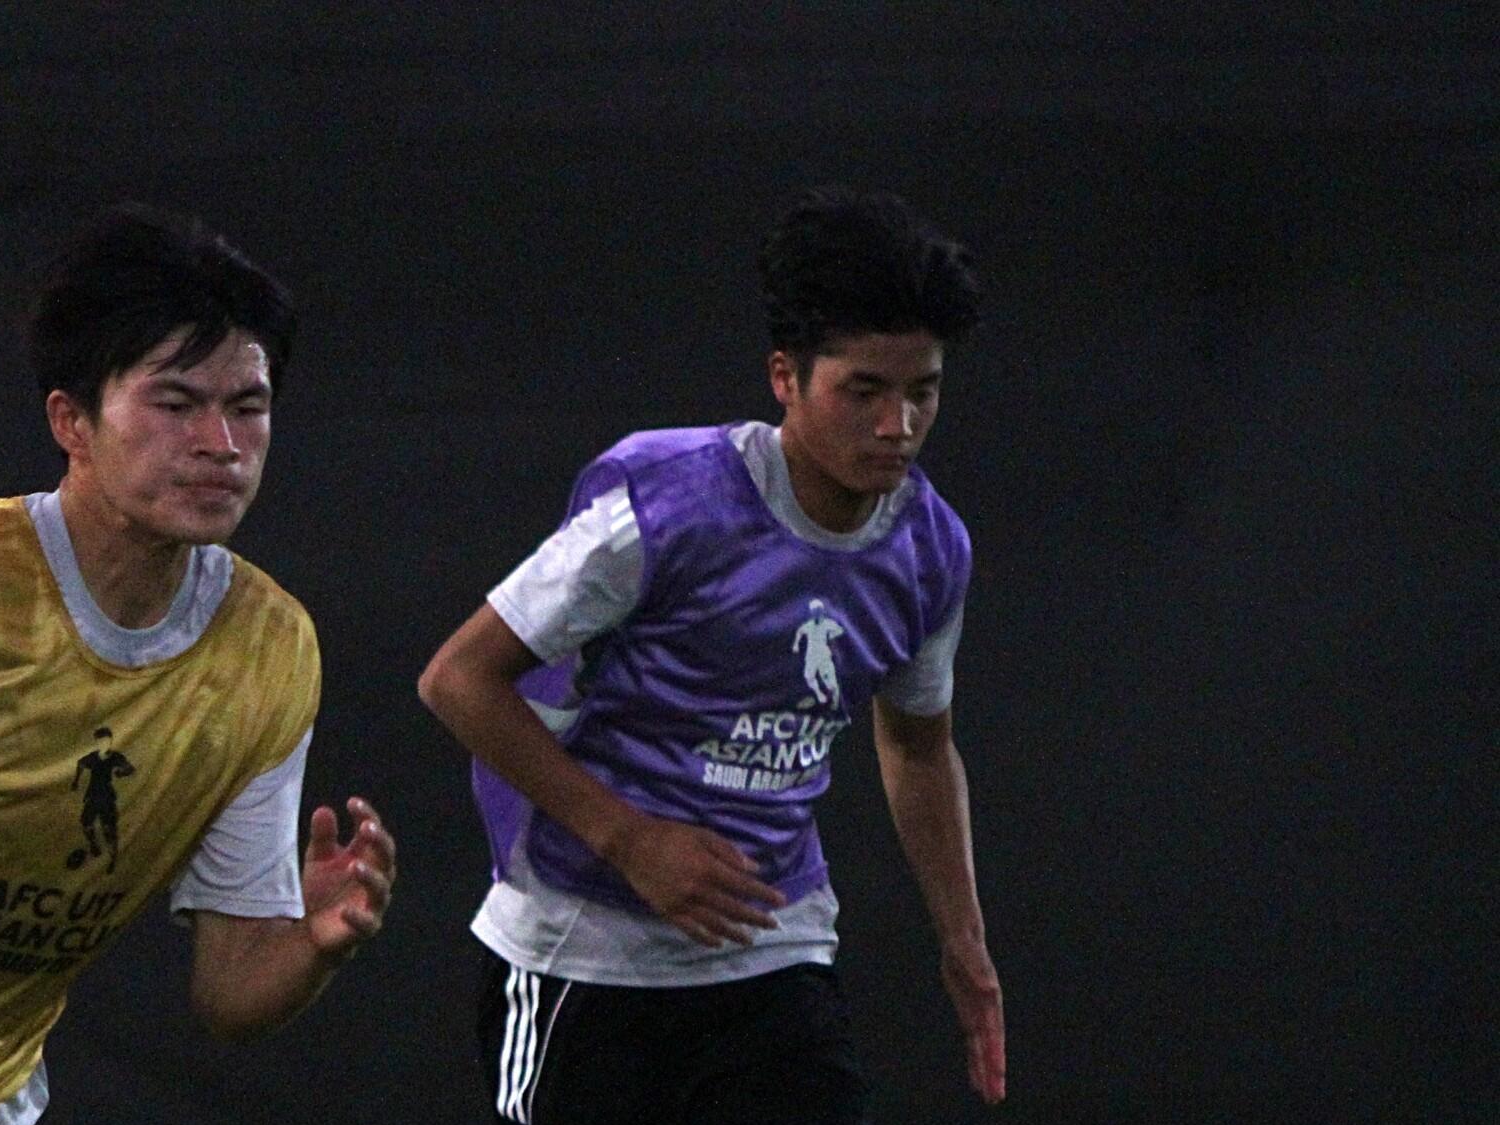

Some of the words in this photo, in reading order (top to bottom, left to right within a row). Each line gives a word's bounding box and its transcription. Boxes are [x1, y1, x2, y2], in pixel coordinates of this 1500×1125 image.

[730, 713, 796, 740] AFC
[693, 739, 799, 770] ASIAN
[703, 762, 748, 790] SAUDI
